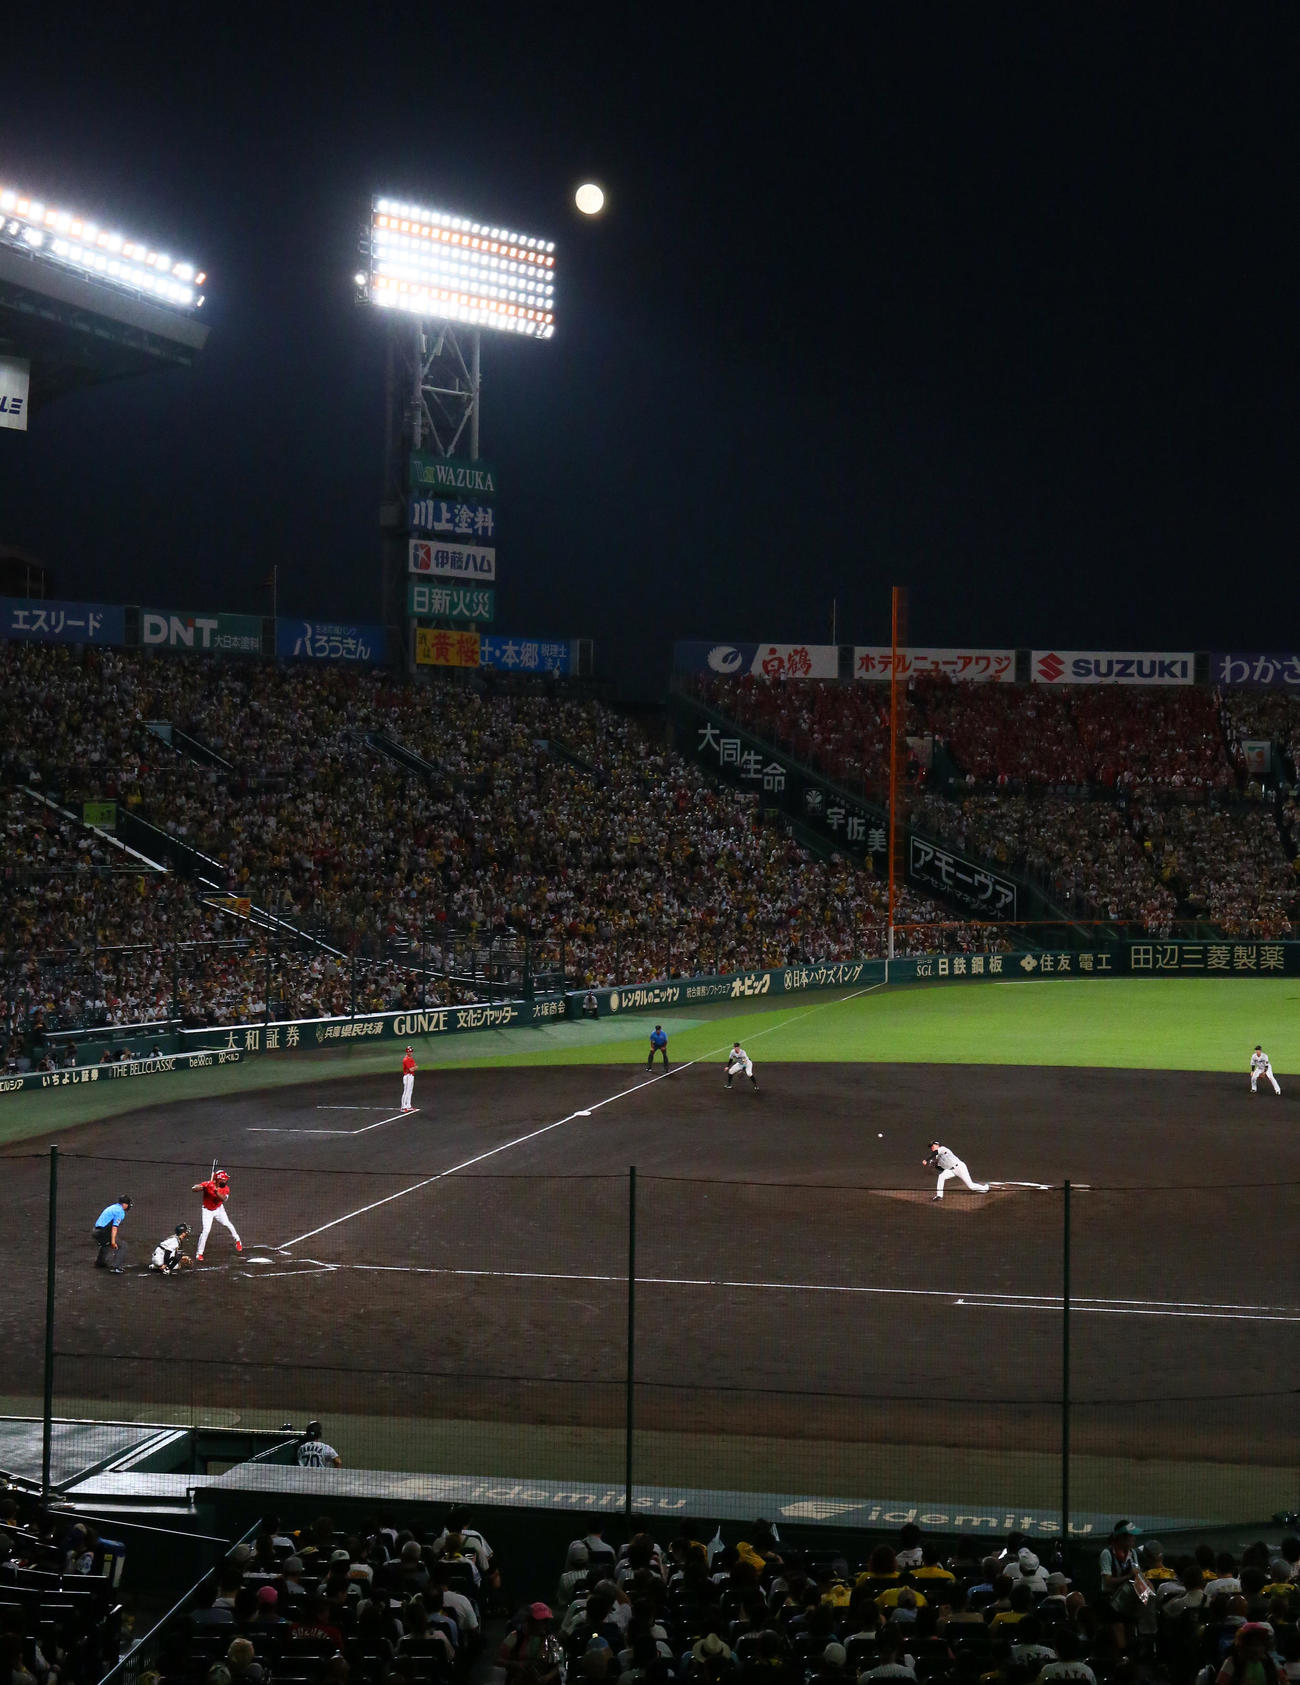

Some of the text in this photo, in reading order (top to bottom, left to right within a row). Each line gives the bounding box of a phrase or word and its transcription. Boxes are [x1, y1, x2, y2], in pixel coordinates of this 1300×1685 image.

[435, 464, 495, 491] WAZUKA
[413, 499, 495, 537] 川上塗料
[434, 549, 492, 573] 伊藤ハム
[413, 586, 489, 618] 日新火災
[11, 609, 103, 637] エスリード
[143, 613, 218, 648] DNT
[214, 635, 260, 651] 大日本塗料
[314, 635, 371, 660] ろうきん
[542, 643, 567, 658] 税理士
[762, 647, 813, 677] 白鶴
[857, 653, 1012, 675] ホテルニューアワジ
[1072, 658, 1188, 679] SUZUKI
[1219, 655, 1300, 684] わかさ
[698, 722, 787, 793] 大同生命
[826, 806, 888, 852] 宇佐美
[913, 840, 1013, 909] アモーヴァ
[916, 955, 1003, 977] SGL 日鉄鋼板
[1040, 953, 1112, 972] 住友電工
[1130, 945, 1285, 970] 田辺三菱製薬
[731, 974, 771, 998] オービック
[793, 963, 864, 987] 日本ハウズイング
[621, 986, 680, 1008] レンタルのニッケン
[533, 1001, 566, 1018] 大塚商会
[324, 1021, 384, 1039] 兵庫県民共済
[393, 1012, 448, 1036] GUNZE
[224, 1026, 300, 1051] 大和証券
[42, 1068, 99, 1087] いちよし証券
[113, 1064, 128, 1078] THE
[471, 1483, 687, 1509] idemitsu
[868, 1507, 1093, 1534] idemitsu
